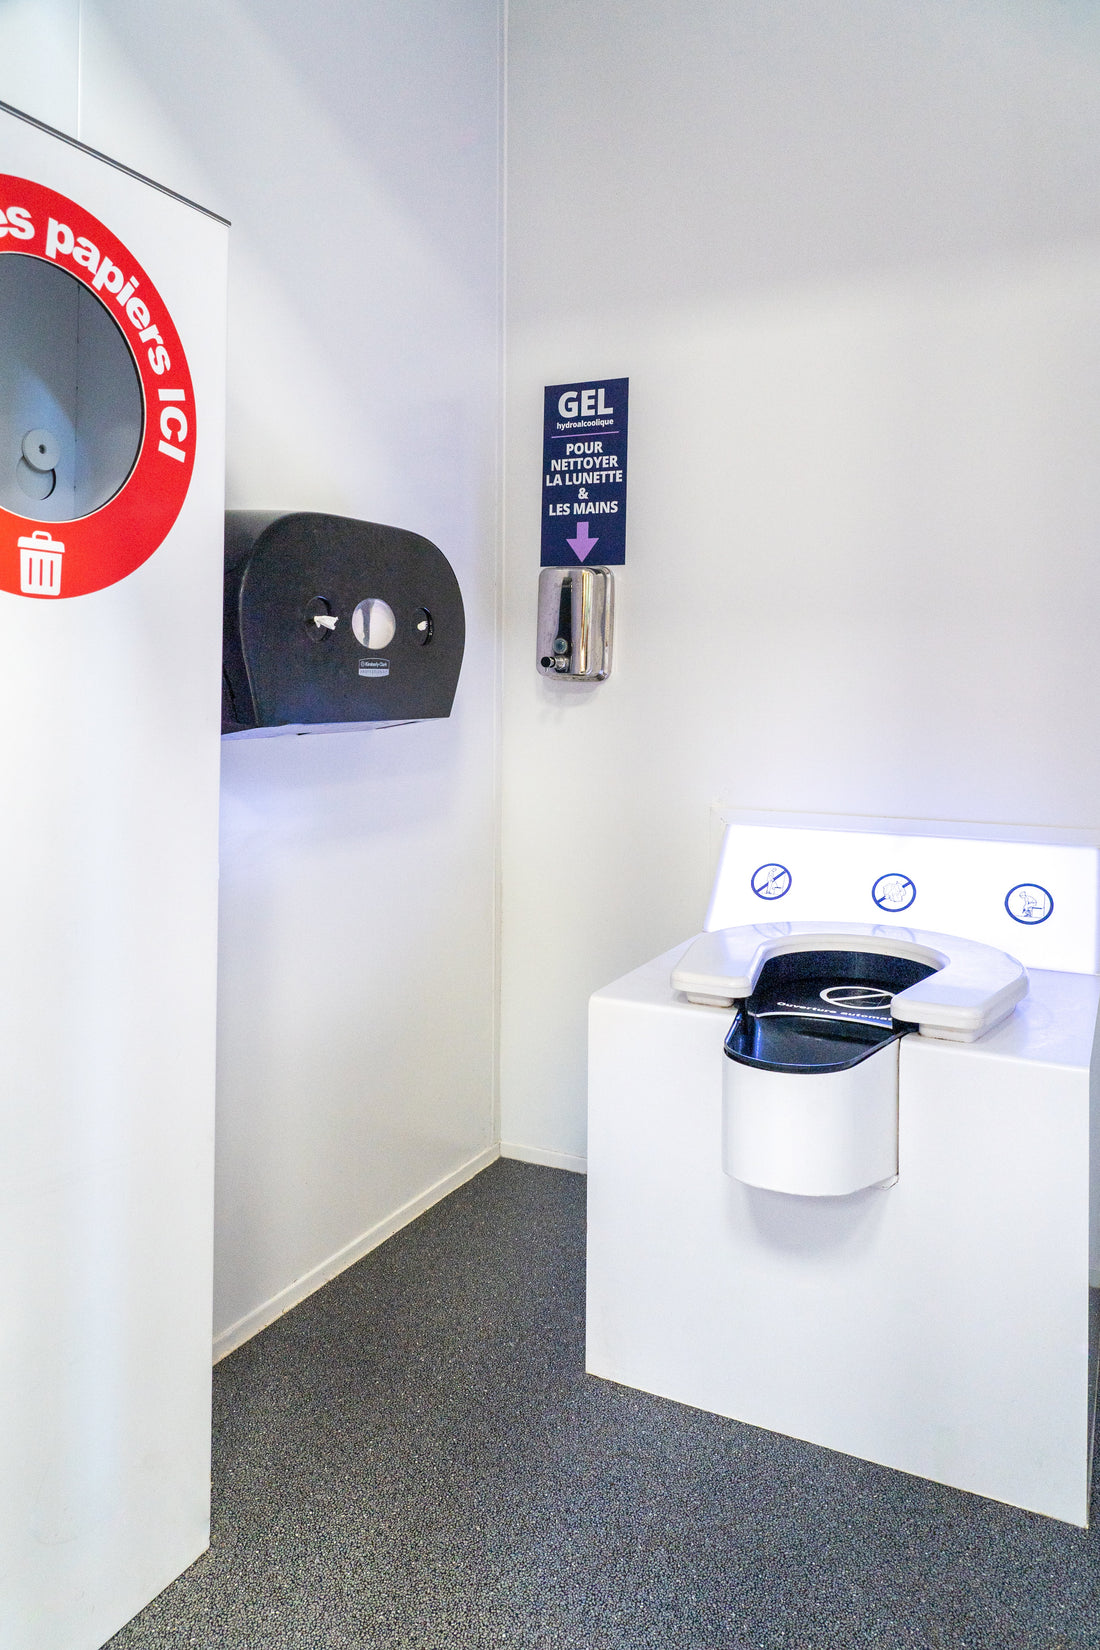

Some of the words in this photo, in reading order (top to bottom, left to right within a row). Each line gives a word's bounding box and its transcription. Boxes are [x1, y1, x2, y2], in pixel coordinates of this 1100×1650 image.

[46, 217, 171, 376] papiers
[157, 388, 189, 464] ICI
[558, 388, 613, 418] GEL
[556, 418, 614, 430] hydroalcoolique
[566, 441, 603, 455] POUR
[551, 455, 618, 471] NETTOYER
[546, 474, 562, 486] LA
[565, 470, 623, 486] LUNETTE
[577, 487, 589, 500] &
[549, 502, 571, 516] LES
[573, 500, 619, 515] MAINS
[777, 1001, 837, 1014] Ouverture
